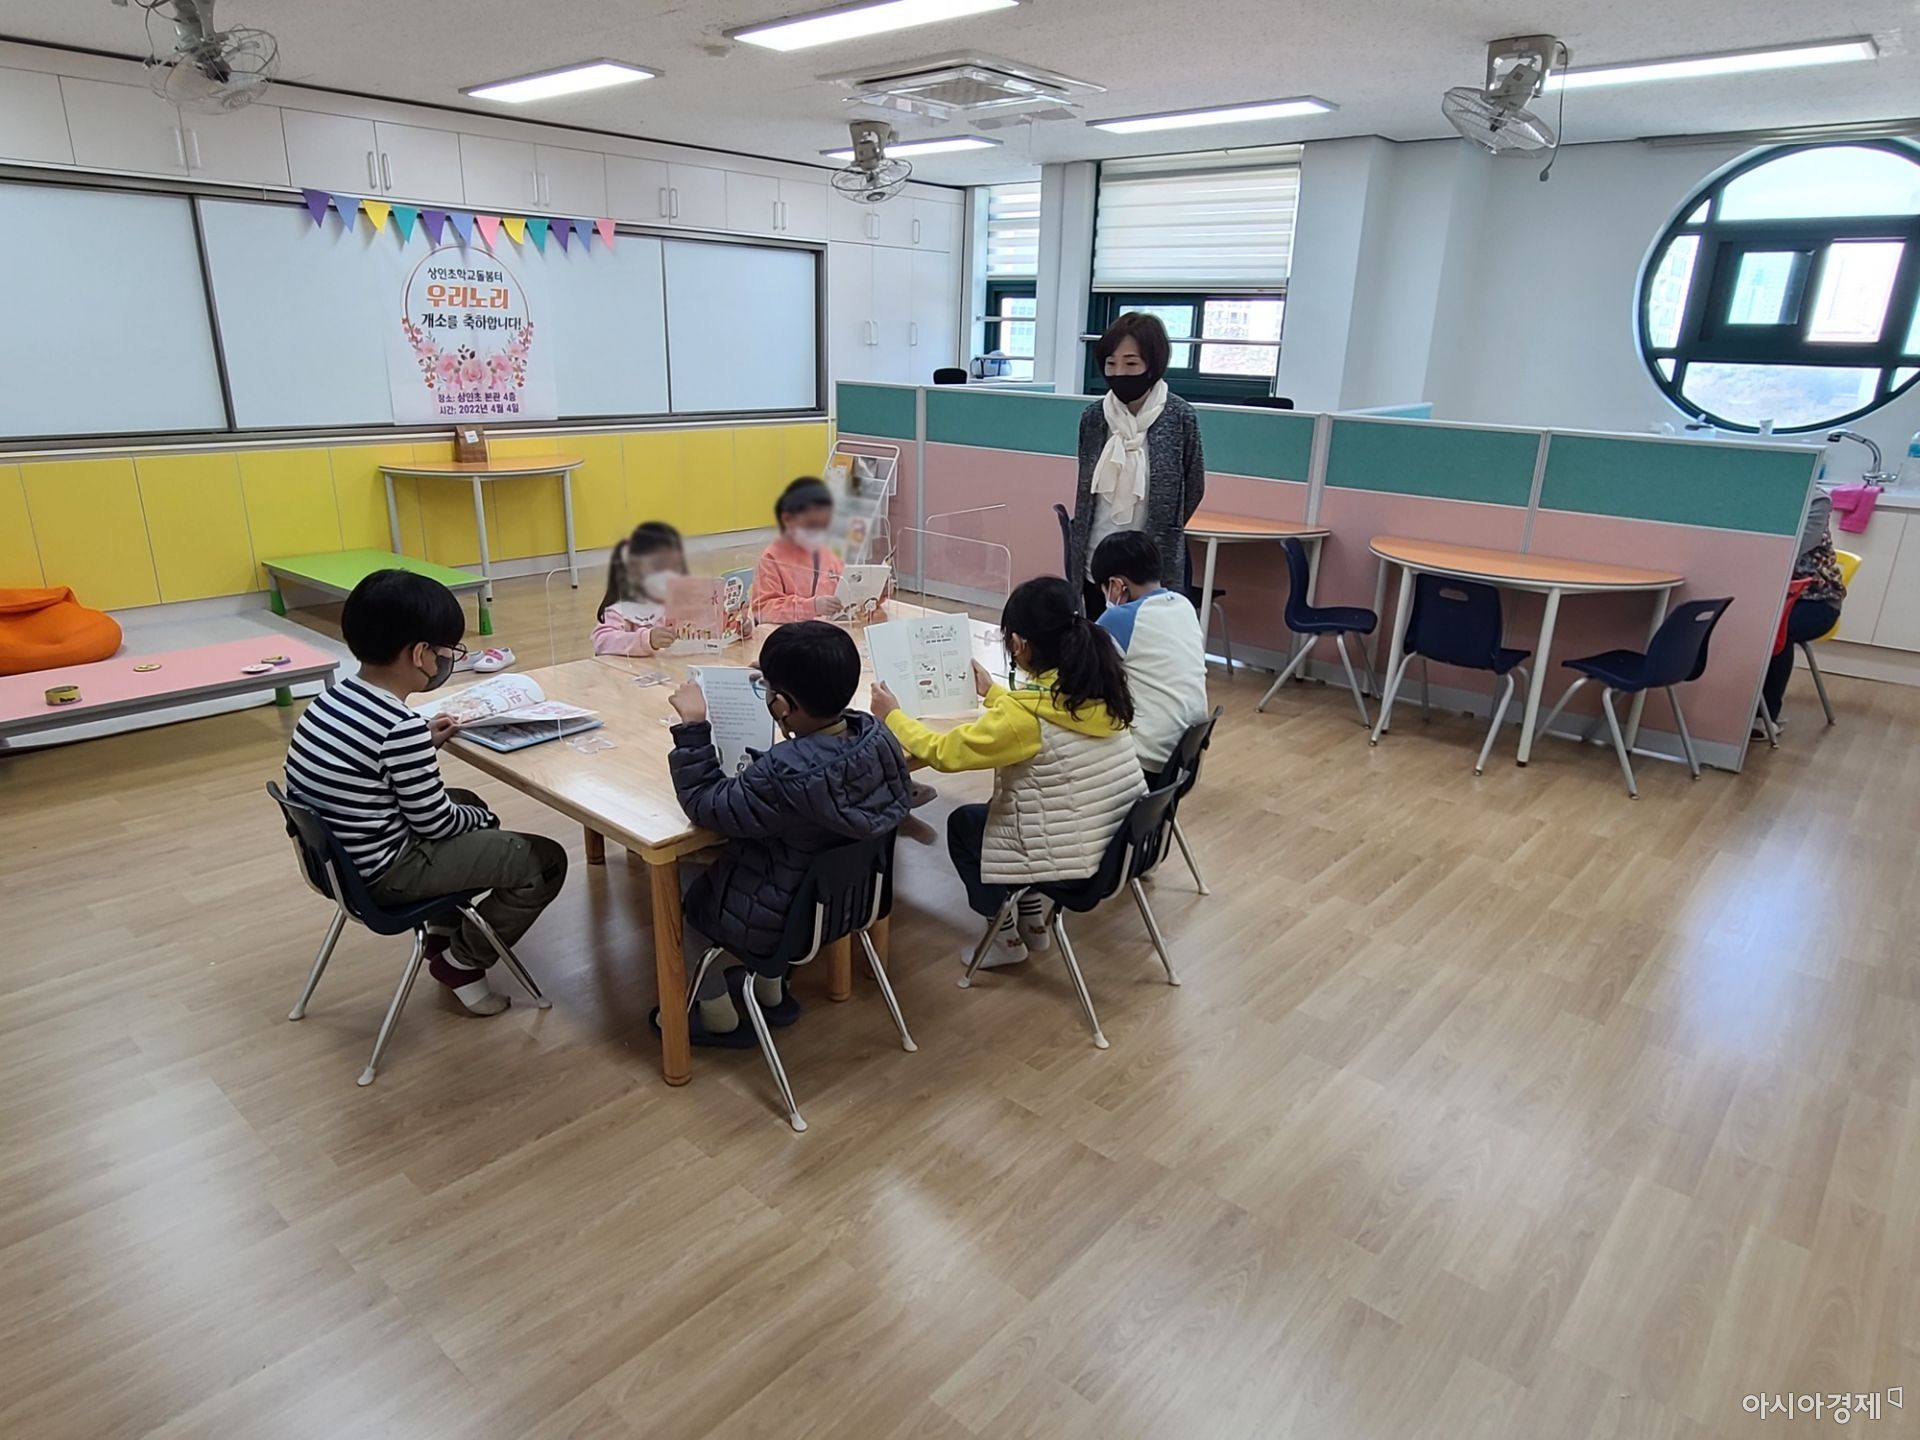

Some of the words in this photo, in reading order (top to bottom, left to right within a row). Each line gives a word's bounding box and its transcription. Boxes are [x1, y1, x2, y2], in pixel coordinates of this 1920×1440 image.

[427, 267, 503, 283] 상인초학교돌봄터
[426, 284, 509, 310] 우리노리
[421, 313, 458, 329] 개소를
[463, 313, 521, 331] 축하합니다!
[438, 393, 455, 403] 장소:
[457, 392, 482, 403] 상인초
[484, 392, 501, 402] 본관
[503, 391, 516, 402] 4층
[439, 405, 457, 415] 시간:
[458, 404, 488, 414] 2022년
[490, 403, 504, 414] 4월
[506, 403, 519, 413] 4일
